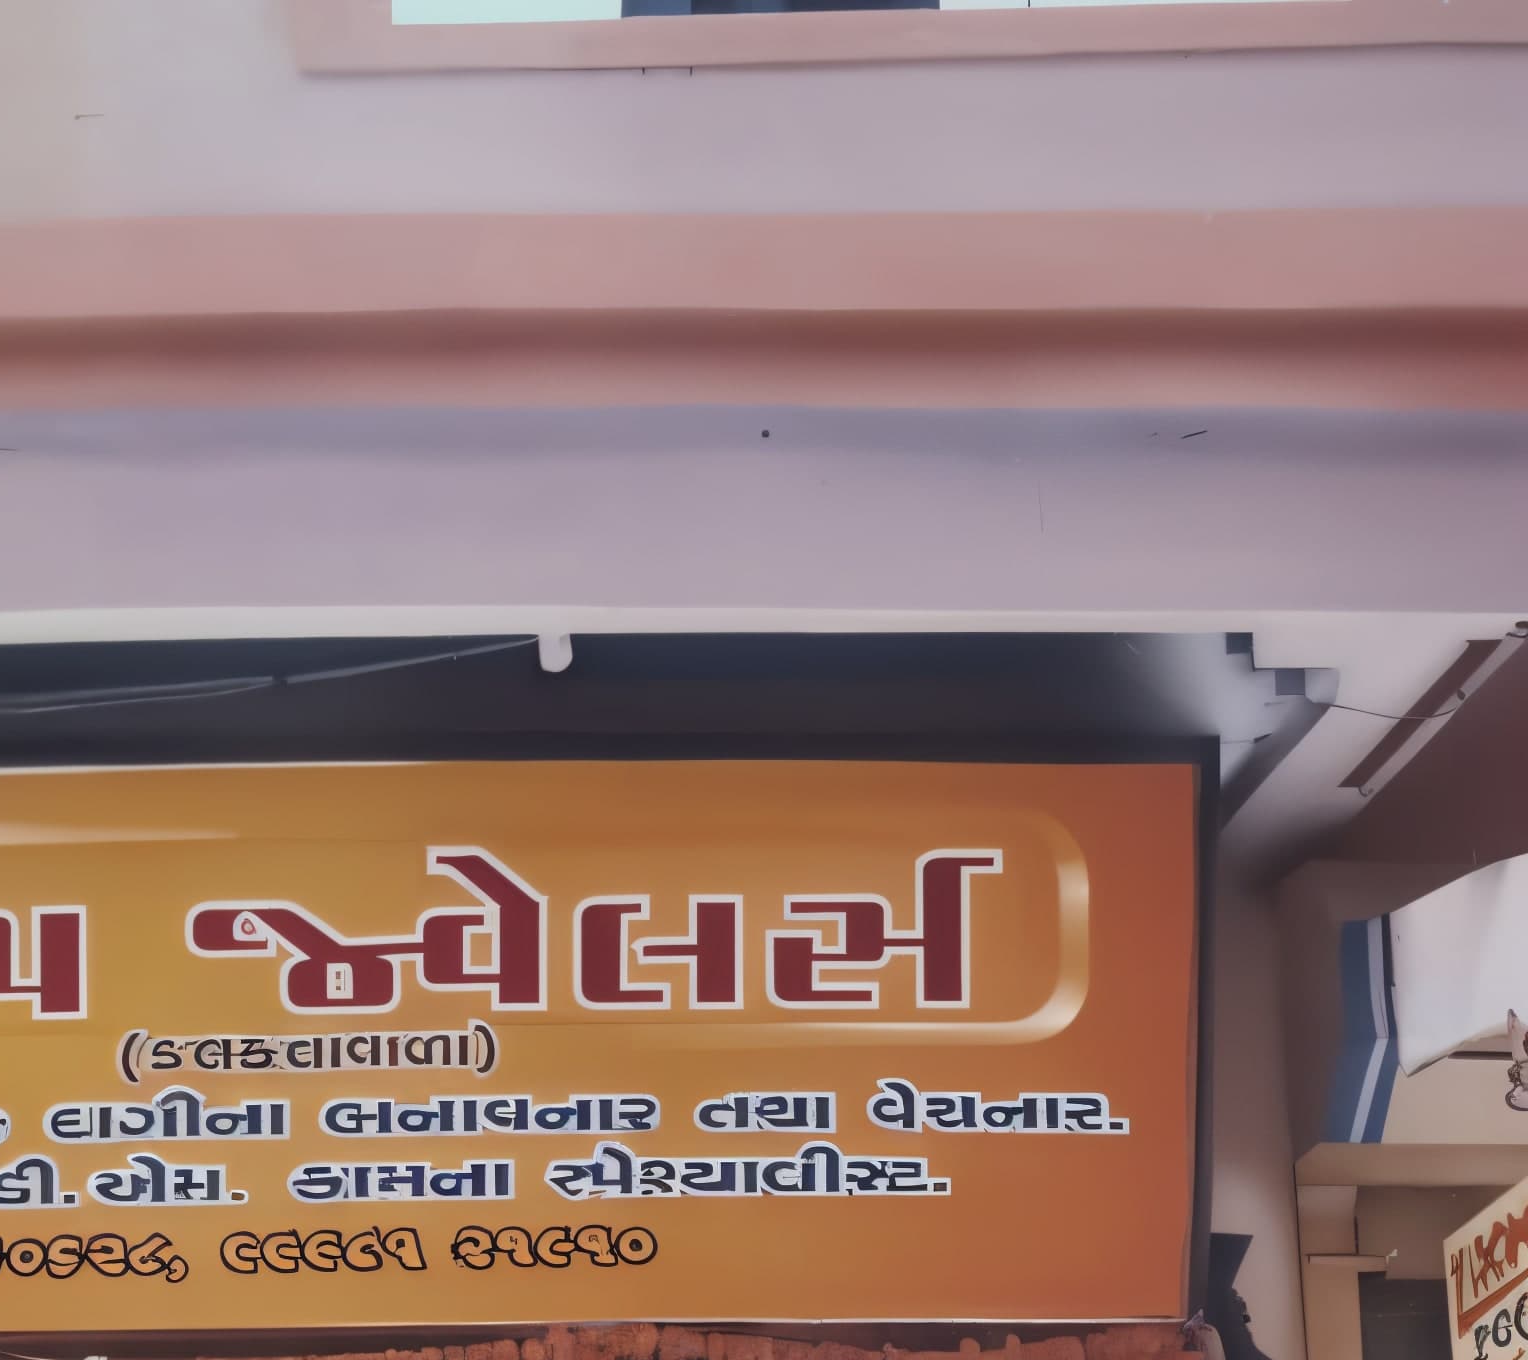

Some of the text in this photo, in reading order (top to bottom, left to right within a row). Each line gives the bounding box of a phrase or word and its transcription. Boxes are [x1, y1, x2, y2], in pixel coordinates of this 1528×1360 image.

[43, 1086, 290, 1143] દાગીના
[319, 1094, 660, 1138] બનાવનાર
[694, 1091, 836, 1133] તથા
[287, 1159, 514, 1203] કામના
